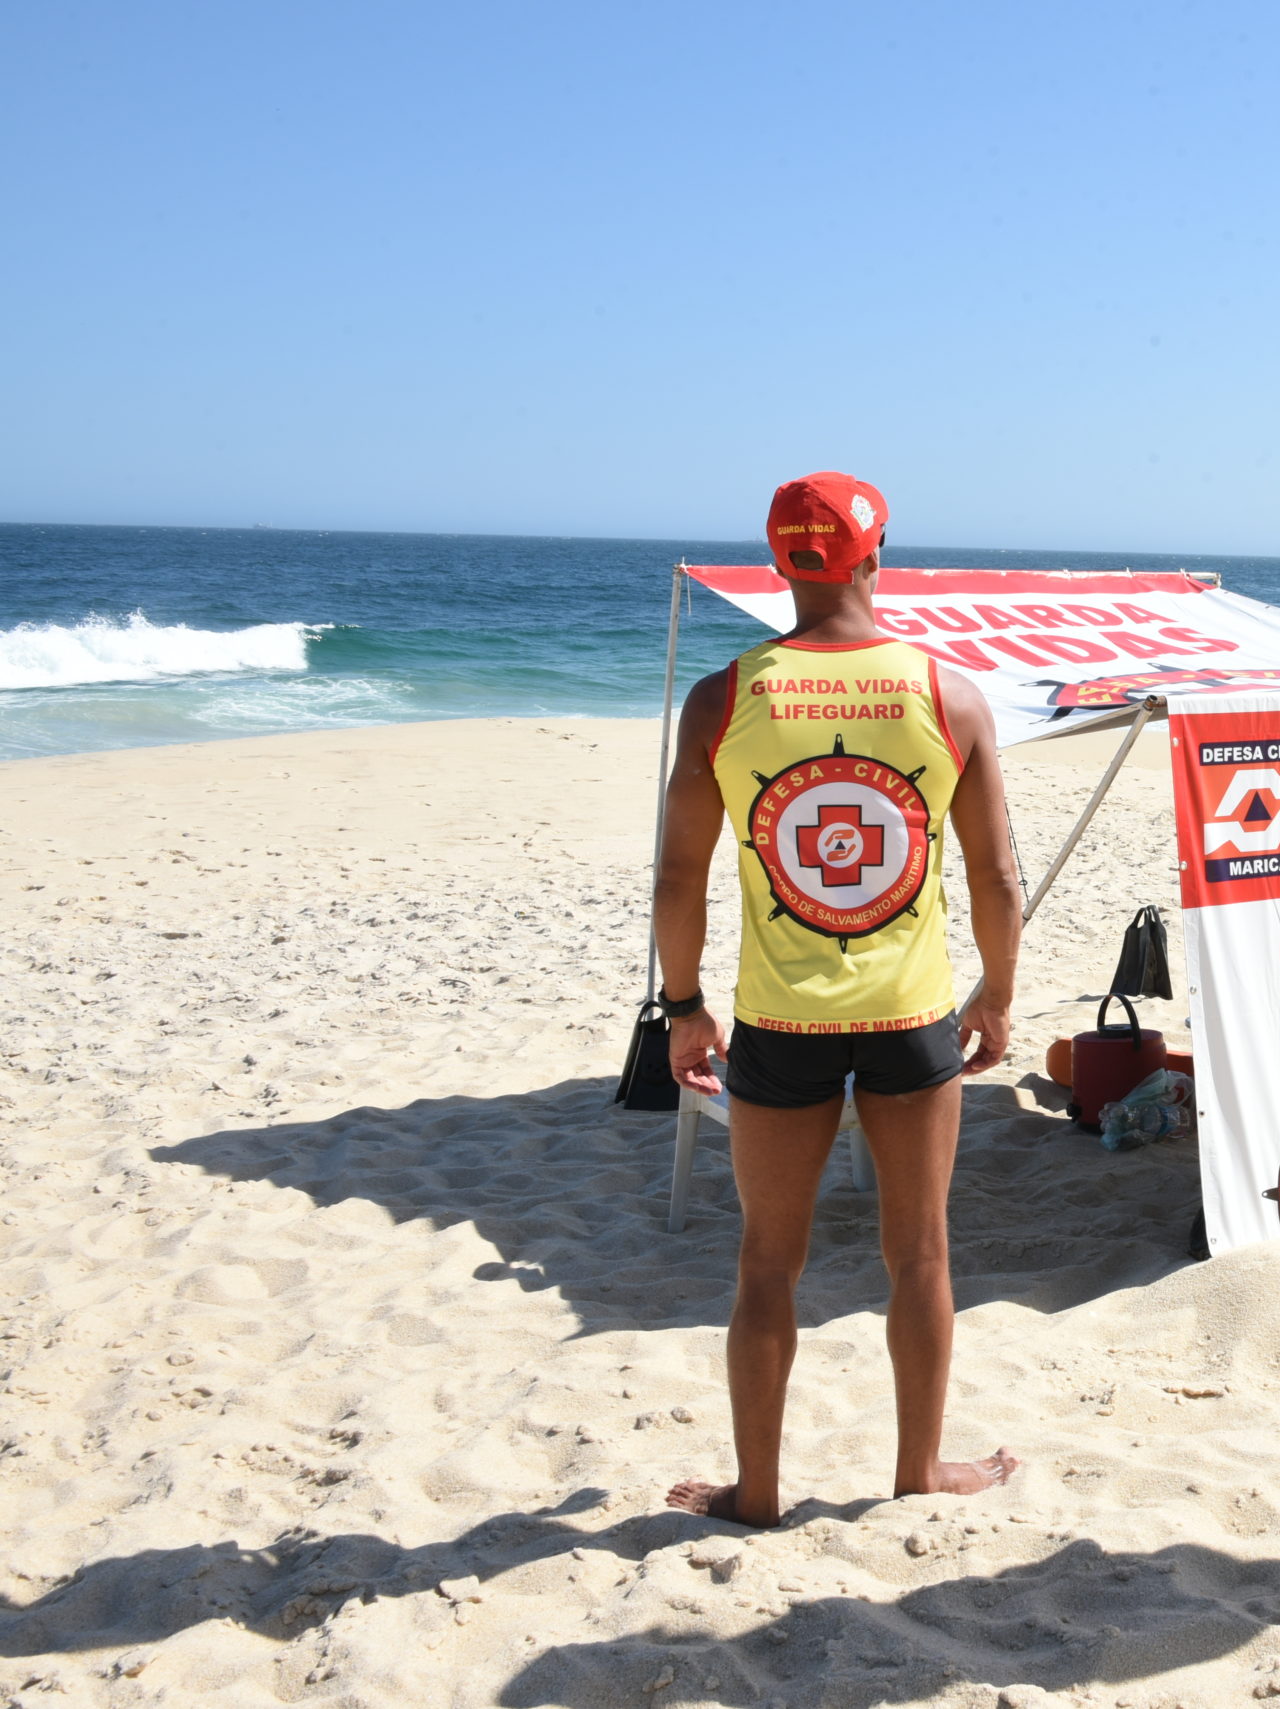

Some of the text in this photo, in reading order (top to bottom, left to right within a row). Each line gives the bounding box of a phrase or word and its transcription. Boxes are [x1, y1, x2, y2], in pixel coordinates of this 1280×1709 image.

[777, 524, 836, 535] GUARDA VIDAS
[873, 602, 1179, 636] GUARDA
[909, 627, 1240, 672] VIDAS
[751, 679, 923, 696] GUARDA VIDAS
[770, 704, 905, 720] LIFEGUARD
[1202, 746, 1264, 763] DEFESA
[756, 763, 918, 845] DEFESA CIVIL
[798, 900, 814, 916] DE
[816, 899, 891, 926] SALVAMENTO
[890, 846, 923, 904] MARÍTIMO
[850, 1021, 868, 1033] DE
